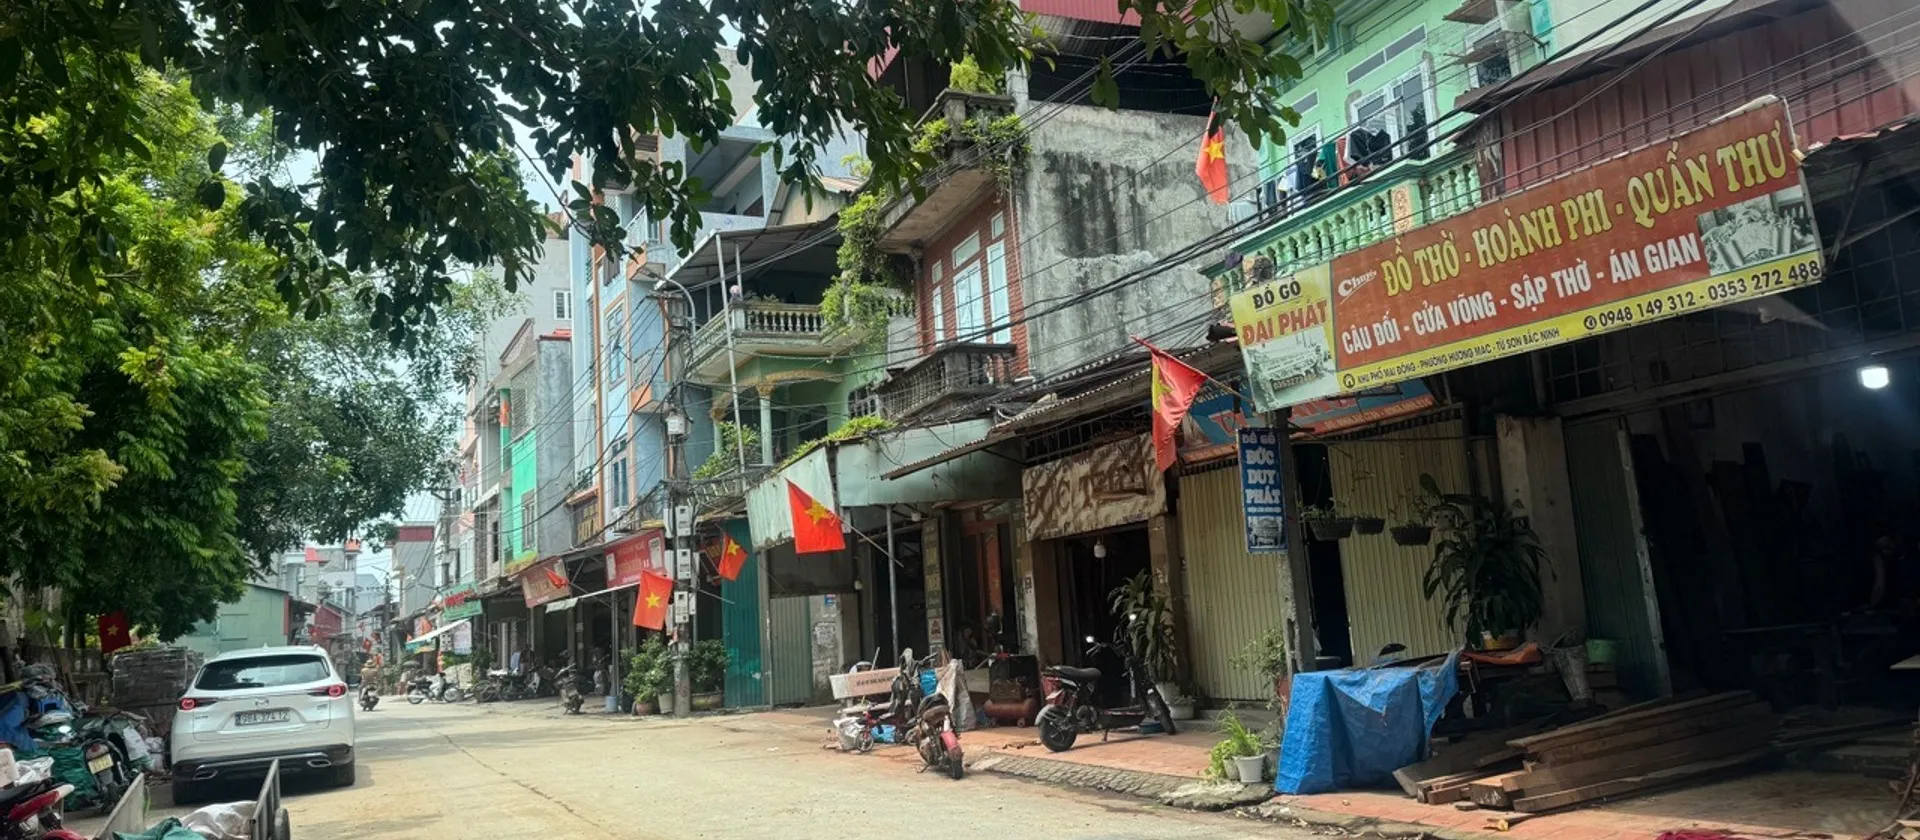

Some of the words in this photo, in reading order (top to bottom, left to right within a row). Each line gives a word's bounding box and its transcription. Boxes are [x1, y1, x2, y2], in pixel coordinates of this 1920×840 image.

[1380, 238, 1413, 297] ĐỒ
[1413, 230, 1460, 286] THỜ
[1472, 208, 1562, 268] HOÀNH
[1563, 188, 1612, 241] PHI
[1627, 141, 1715, 228] QUẤN
[1716, 120, 1787, 192] THƯ
[1242, 317, 1275, 347] ĐẠI
[1278, 298, 1328, 336] PHÁT
[1342, 325, 1372, 355] CÂU
[1373, 308, 1401, 347] ĐỐI
[1412, 300, 1448, 336] CỬA
[1448, 290, 1497, 326] VÕNG
[1510, 274, 1548, 312] SẬP
[1551, 257, 1592, 298] THỜ
[1609, 248, 1642, 284] ÁN
[1643, 232, 1701, 274] GIAN
[1599, 306, 1633, 327] 0948
[1637, 299, 1663, 318] 149
[1669, 291, 1696, 311] 312
[1708, 277, 1748, 301] 0353
[1751, 268, 1783, 291] 272
[1788, 260, 1821, 281] 488
[1245, 485, 1281, 504] PHÁT
[1247, 469, 1276, 485] DUY
